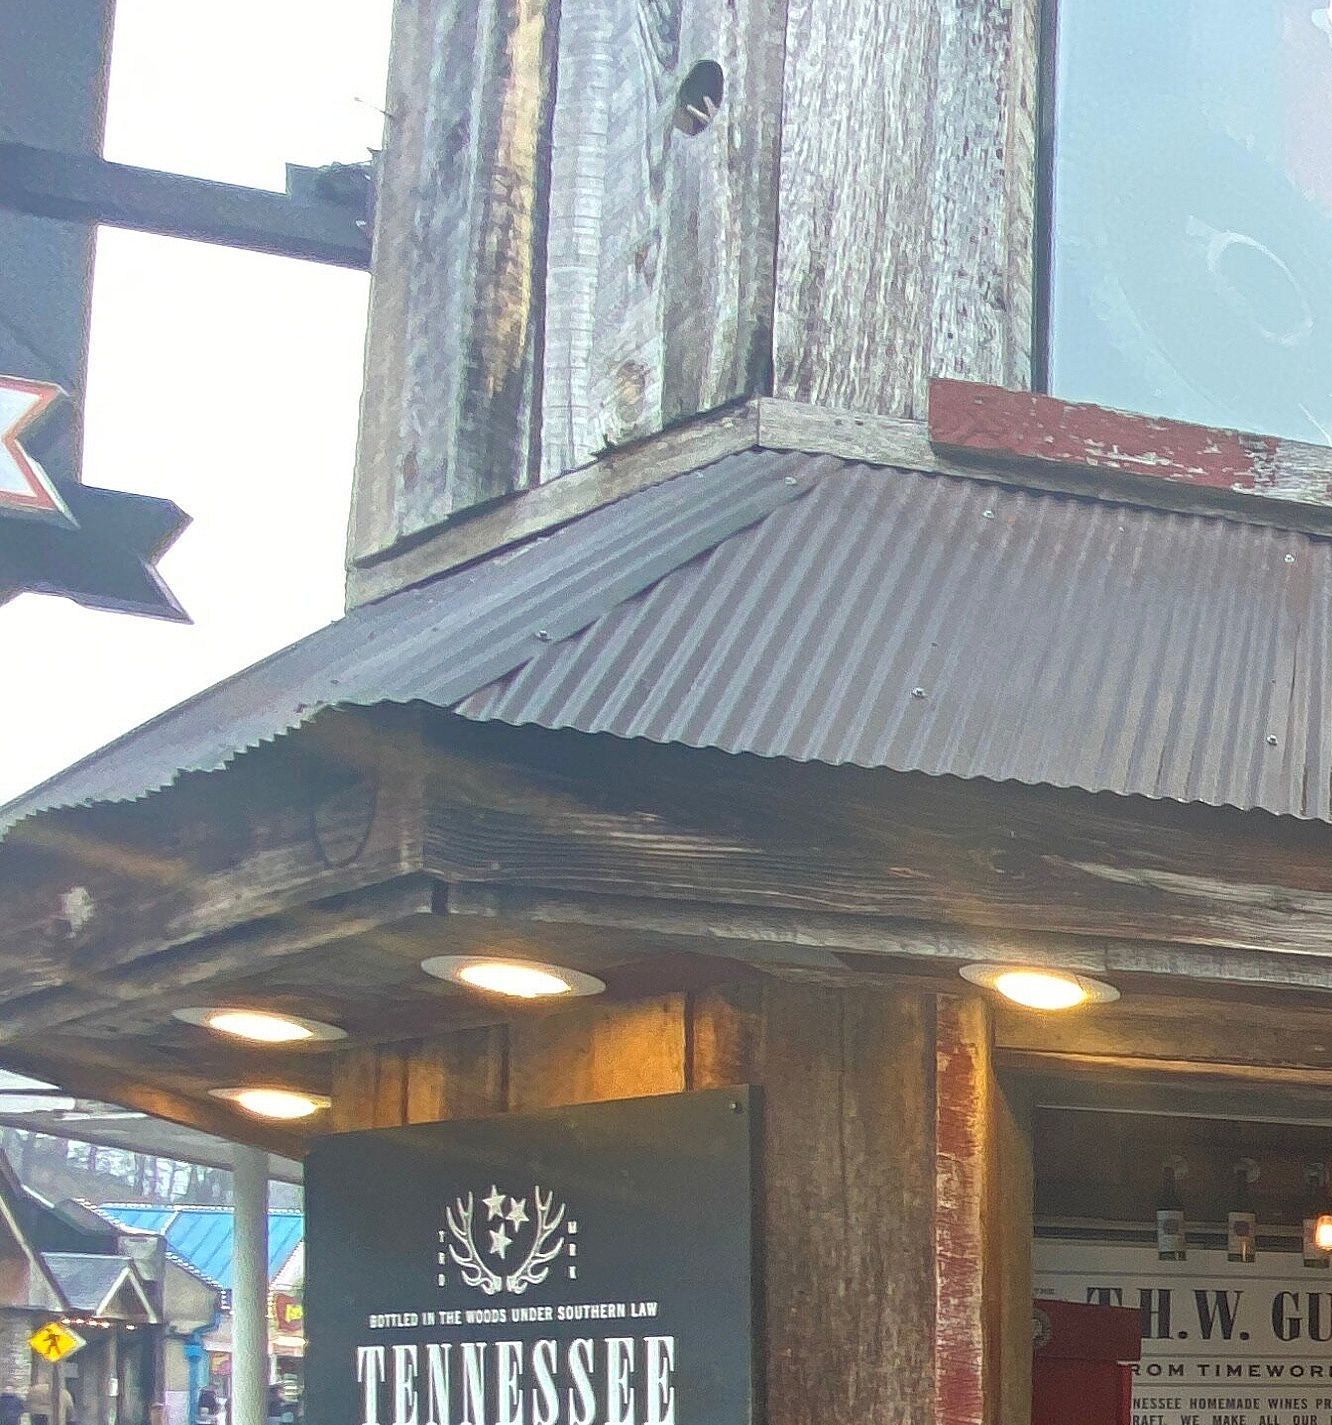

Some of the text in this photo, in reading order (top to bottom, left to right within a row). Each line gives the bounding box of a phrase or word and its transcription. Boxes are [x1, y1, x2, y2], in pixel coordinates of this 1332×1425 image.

[369, 1302, 658, 1328] BOTTLED IN THE WOODS UNDER SOUTHERN LAW
[1087, 1287, 1249, 1340] H.W.
[1131, 1363, 1184, 1377] ROM
[1132, 1398, 1182, 1410] NESSEE
[1189, 1398, 1260, 1410] HOMEMADE
[1268, 1398, 1308, 1410] WINES
[1259, 1415, 1280, 1425] ALL
[1293, 1415, 1318, 1425] OUR
